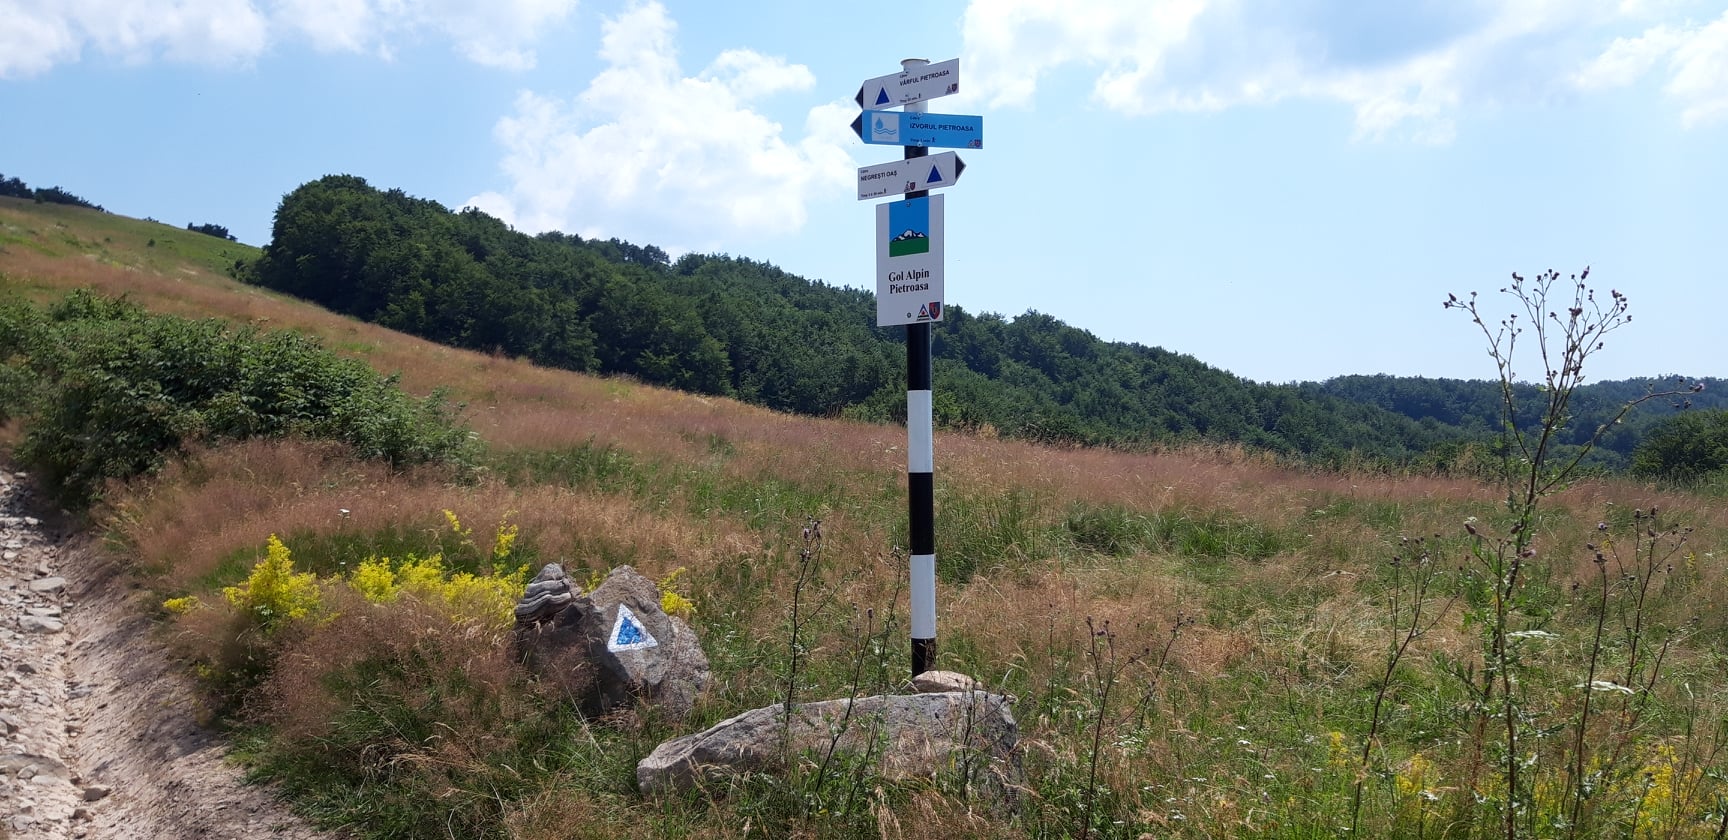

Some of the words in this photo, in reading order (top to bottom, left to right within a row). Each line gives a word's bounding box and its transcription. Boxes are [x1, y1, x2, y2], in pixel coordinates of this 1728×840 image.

[920, 70, 950, 81] PIETROASA
[938, 124, 974, 132] PIETROASA
[889, 271, 904, 282] Gol
[906, 268, 930, 281] Alpin
[889, 283, 929, 294] Pietroasa
